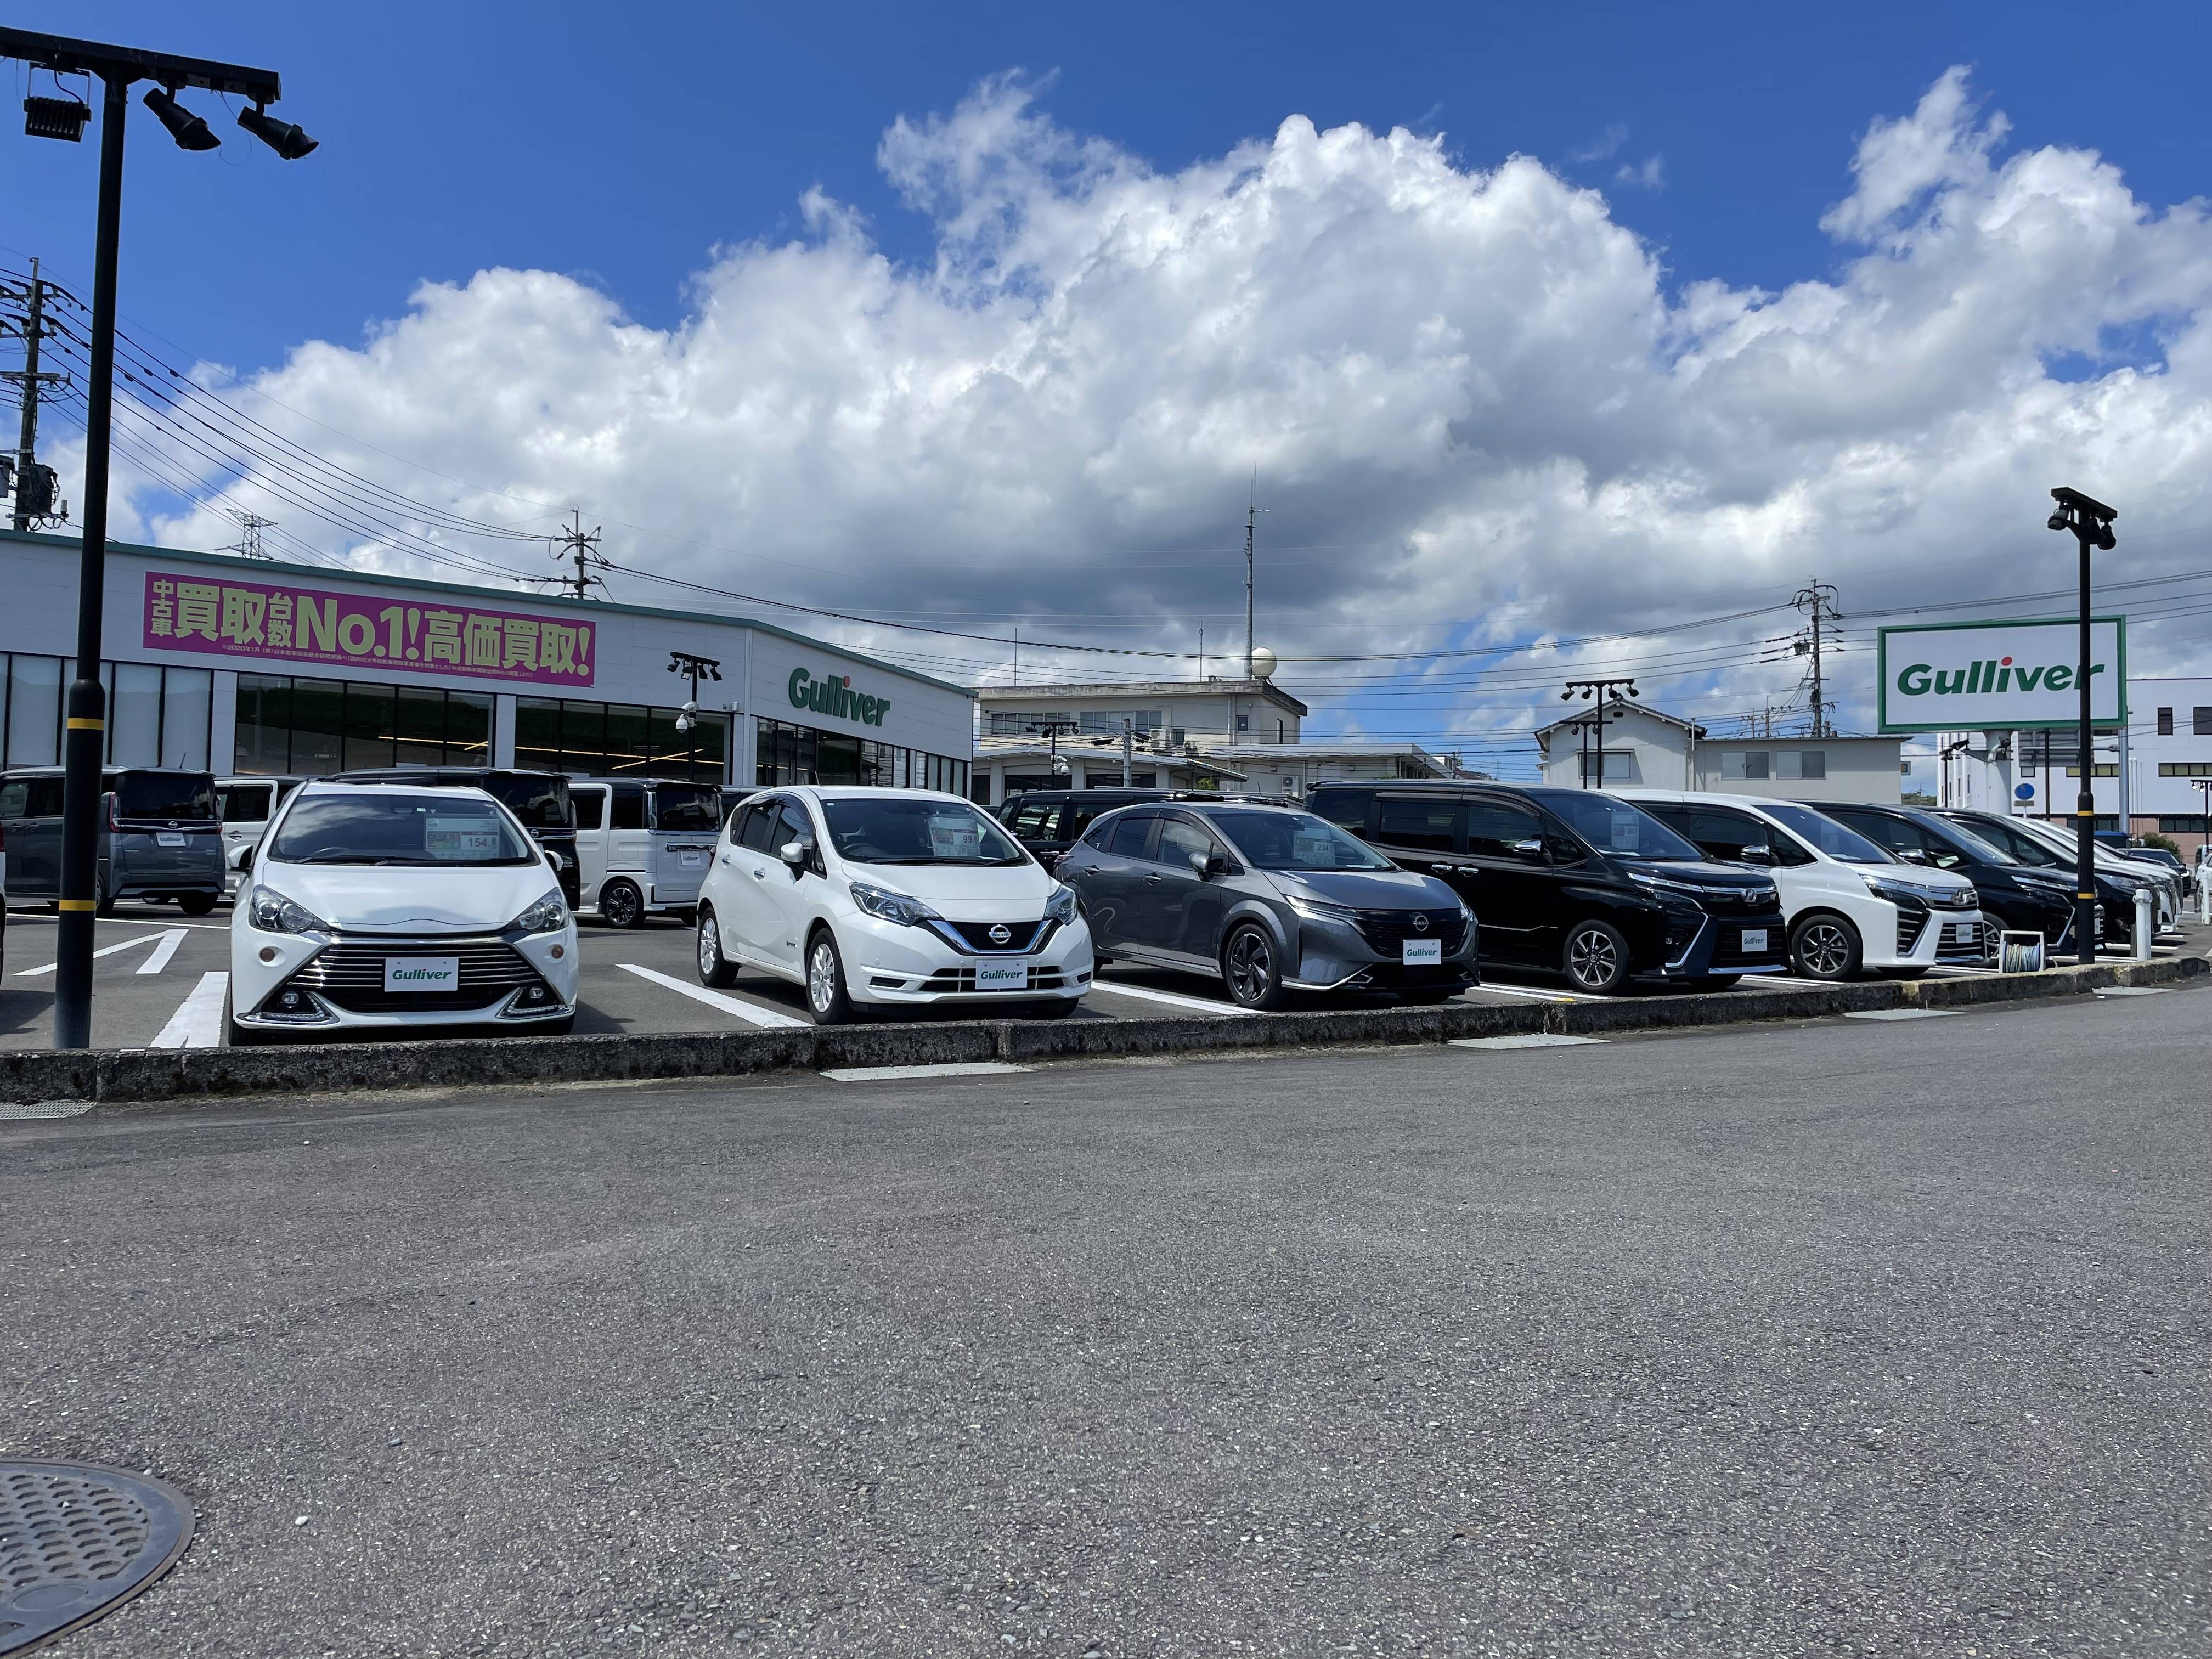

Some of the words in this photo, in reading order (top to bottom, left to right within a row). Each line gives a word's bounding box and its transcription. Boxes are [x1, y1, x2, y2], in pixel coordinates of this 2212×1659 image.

[1897, 656, 2105, 696] Gulliver
[788, 667, 890, 727] Gulliver
[1407, 948, 1437, 956] Gulliver
[392, 969, 452, 980] Gulliver
[981, 969, 1023, 979] Gulliver
